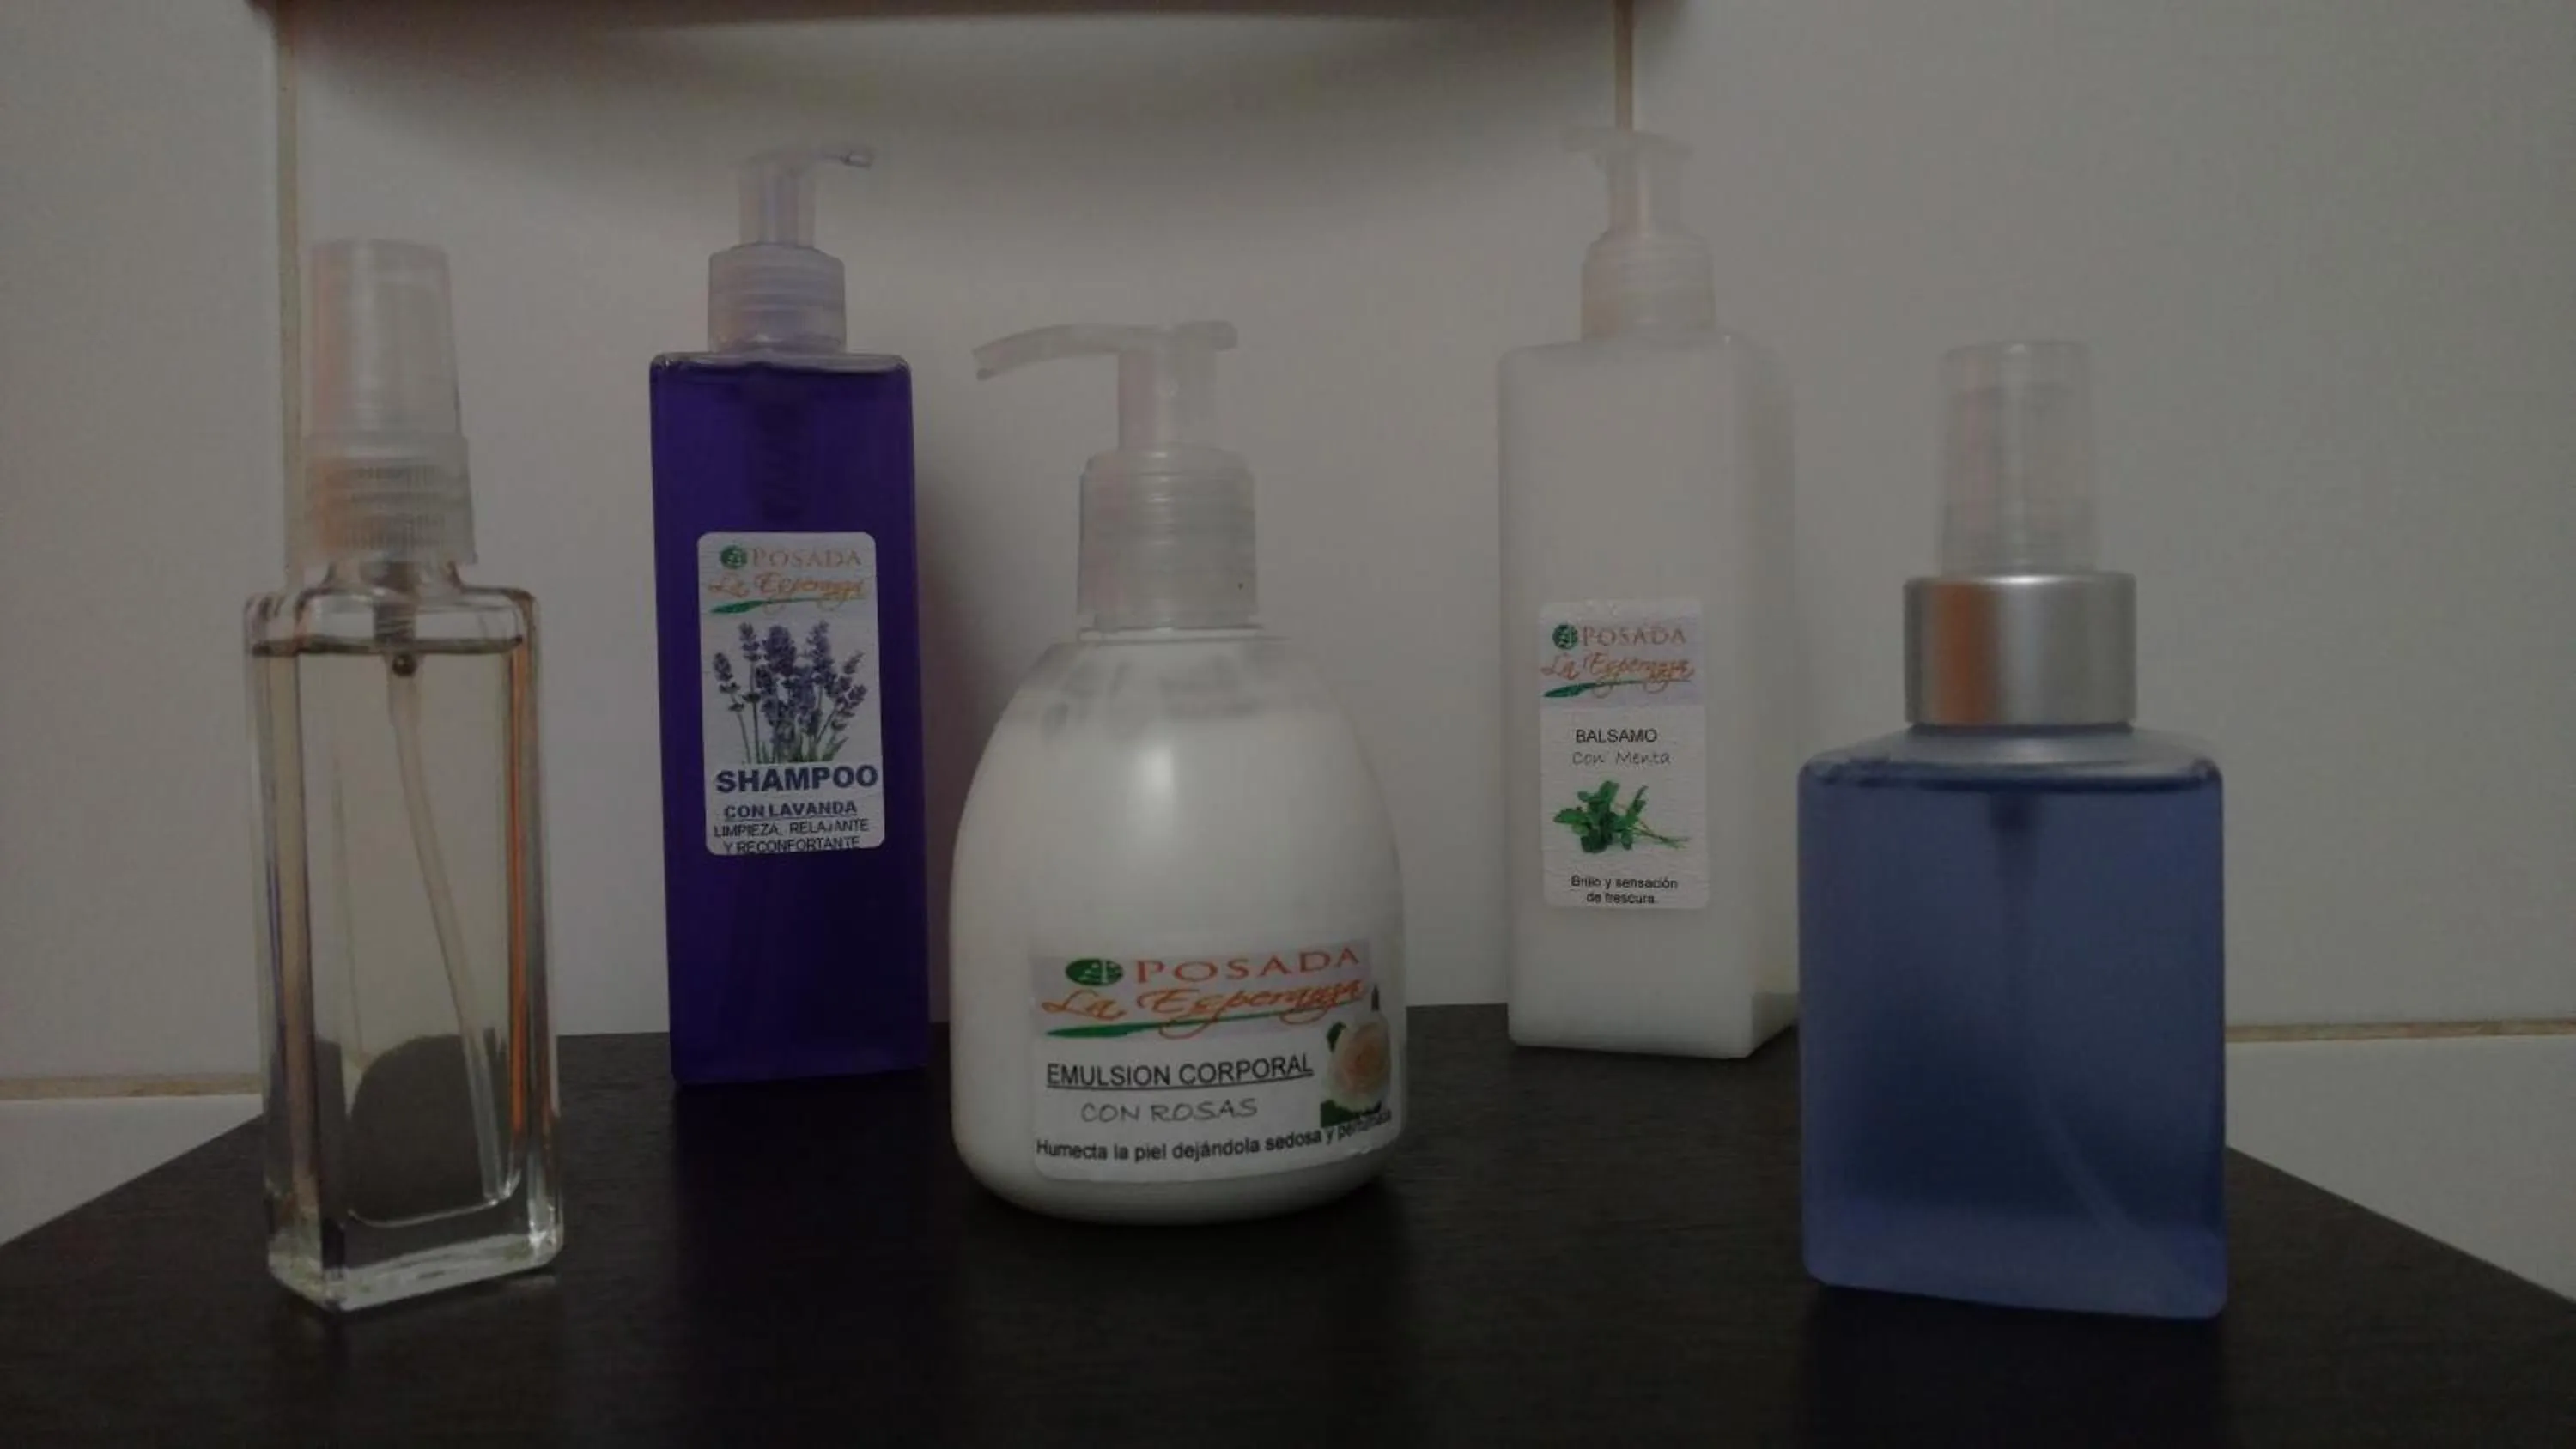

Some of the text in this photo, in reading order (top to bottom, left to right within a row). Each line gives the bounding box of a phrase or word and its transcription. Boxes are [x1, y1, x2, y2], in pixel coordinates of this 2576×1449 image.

[752, 547, 862, 567] POSADA
[1582, 625, 1687, 646] POSADA
[1575, 728, 1658, 743] BALSAMO
[1572, 751, 1673, 766] Con Menta
[716, 764, 878, 794] SHAMPOO
[723, 800, 858, 818] CON LAVANDA
[789, 817, 870, 834] RELAJANTE
[736, 835, 860, 854] RECONFORTANTE
[1605, 878, 1613, 890] y
[1615, 877, 1679, 889] sensación
[1586, 893, 1601, 903] de
[1135, 947, 1362, 985] POSADA
[1041, 988, 1128, 1022] La
[1045, 1052, 1315, 1089] EMULSION CORPORAL
[1080, 1098, 1259, 1124] CON ROSAS
[1036, 1139, 1108, 1161] Humecta
[1114, 1140, 1129, 1161] la
[1134, 1140, 1167, 1163] piel
[1172, 1136, 1261, 1162] dejándola
[1264, 1131, 1322, 1152] sedosa
[1325, 1128, 1334, 1146] y
